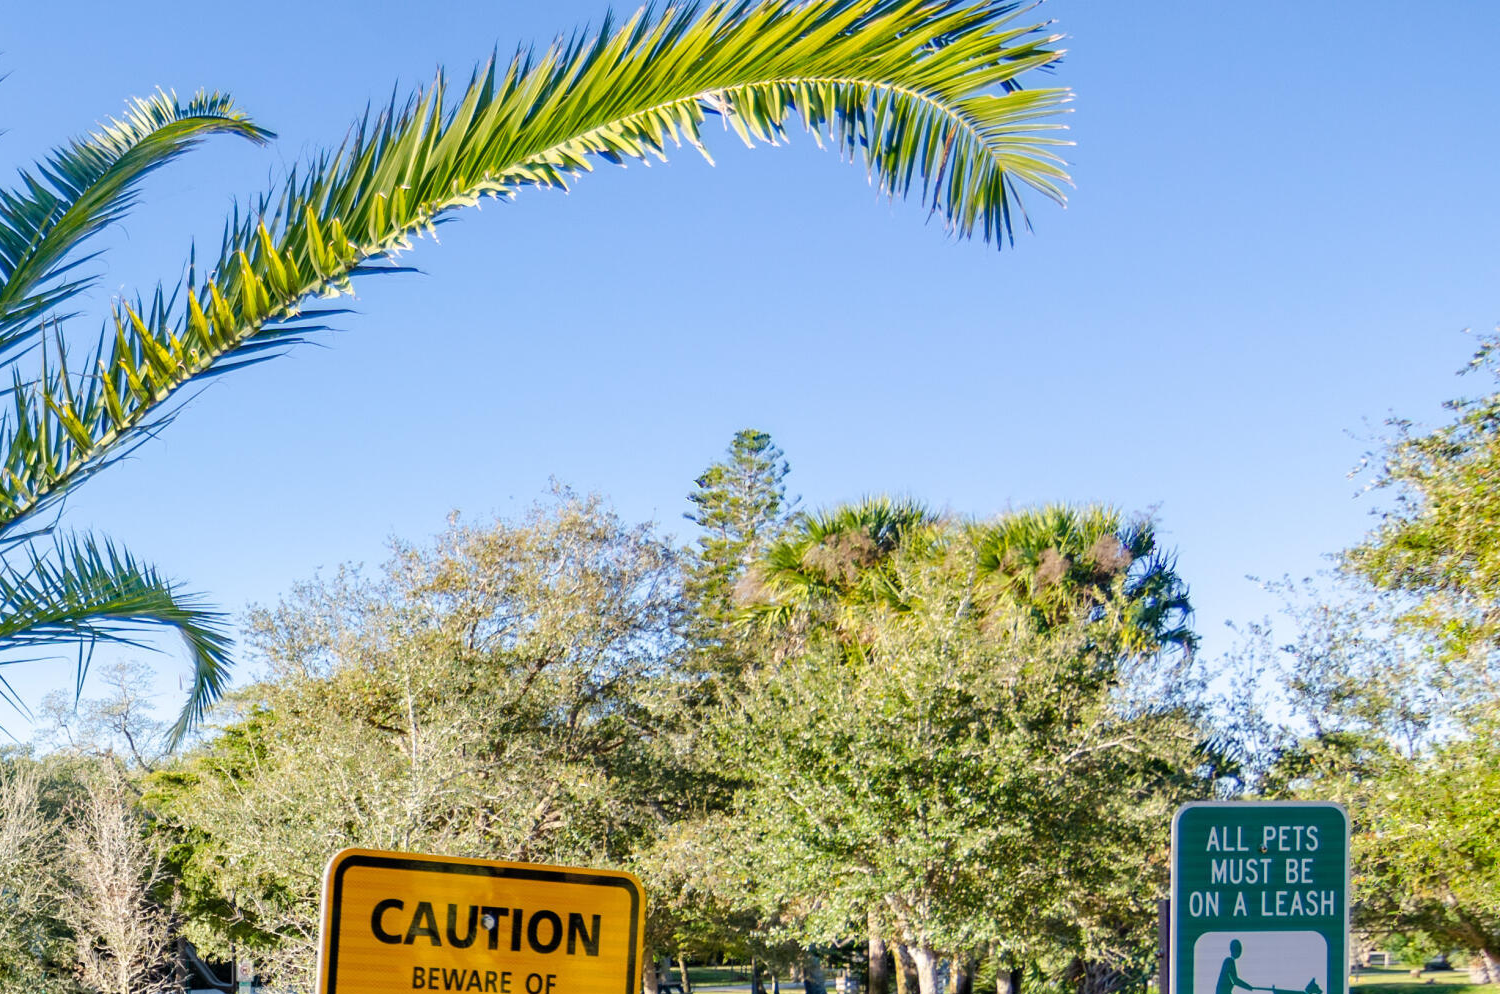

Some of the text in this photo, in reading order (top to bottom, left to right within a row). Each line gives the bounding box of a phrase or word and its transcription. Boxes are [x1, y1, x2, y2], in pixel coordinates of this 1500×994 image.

[1206, 826, 1319, 851] ALL PETS
[1212, 858, 1313, 884] MUST BE
[1189, 891, 1335, 916] ON A LEASH
[371, 899, 601, 956] CAUTION
[413, 967, 557, 994] BEWARE OF
